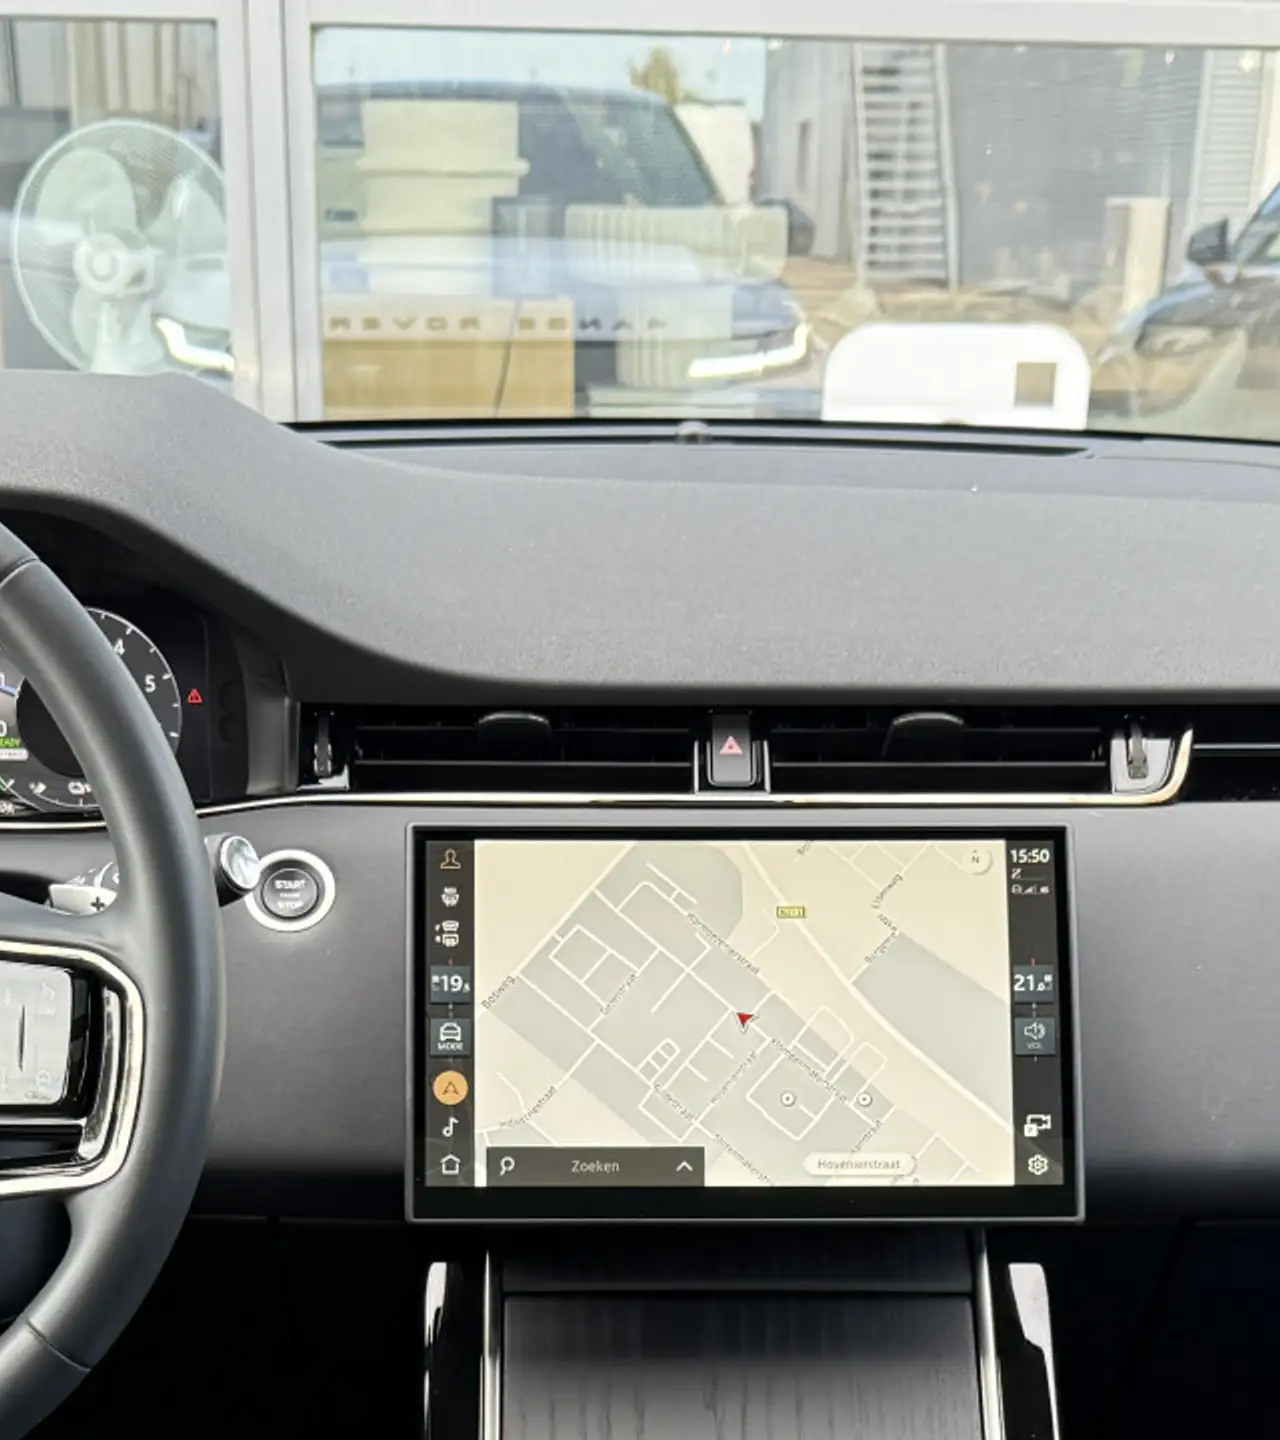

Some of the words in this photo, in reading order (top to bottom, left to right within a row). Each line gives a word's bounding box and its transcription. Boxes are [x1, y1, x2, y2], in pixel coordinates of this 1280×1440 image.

[113, 638, 125, 655] 4
[144, 675, 157, 692] 5
[1010, 848, 1050, 864] 15:50
[437, 1042, 464, 1051] MODE
[1026, 1042, 1042, 1050] VOL
[571, 1160, 620, 1173] Zoeken
